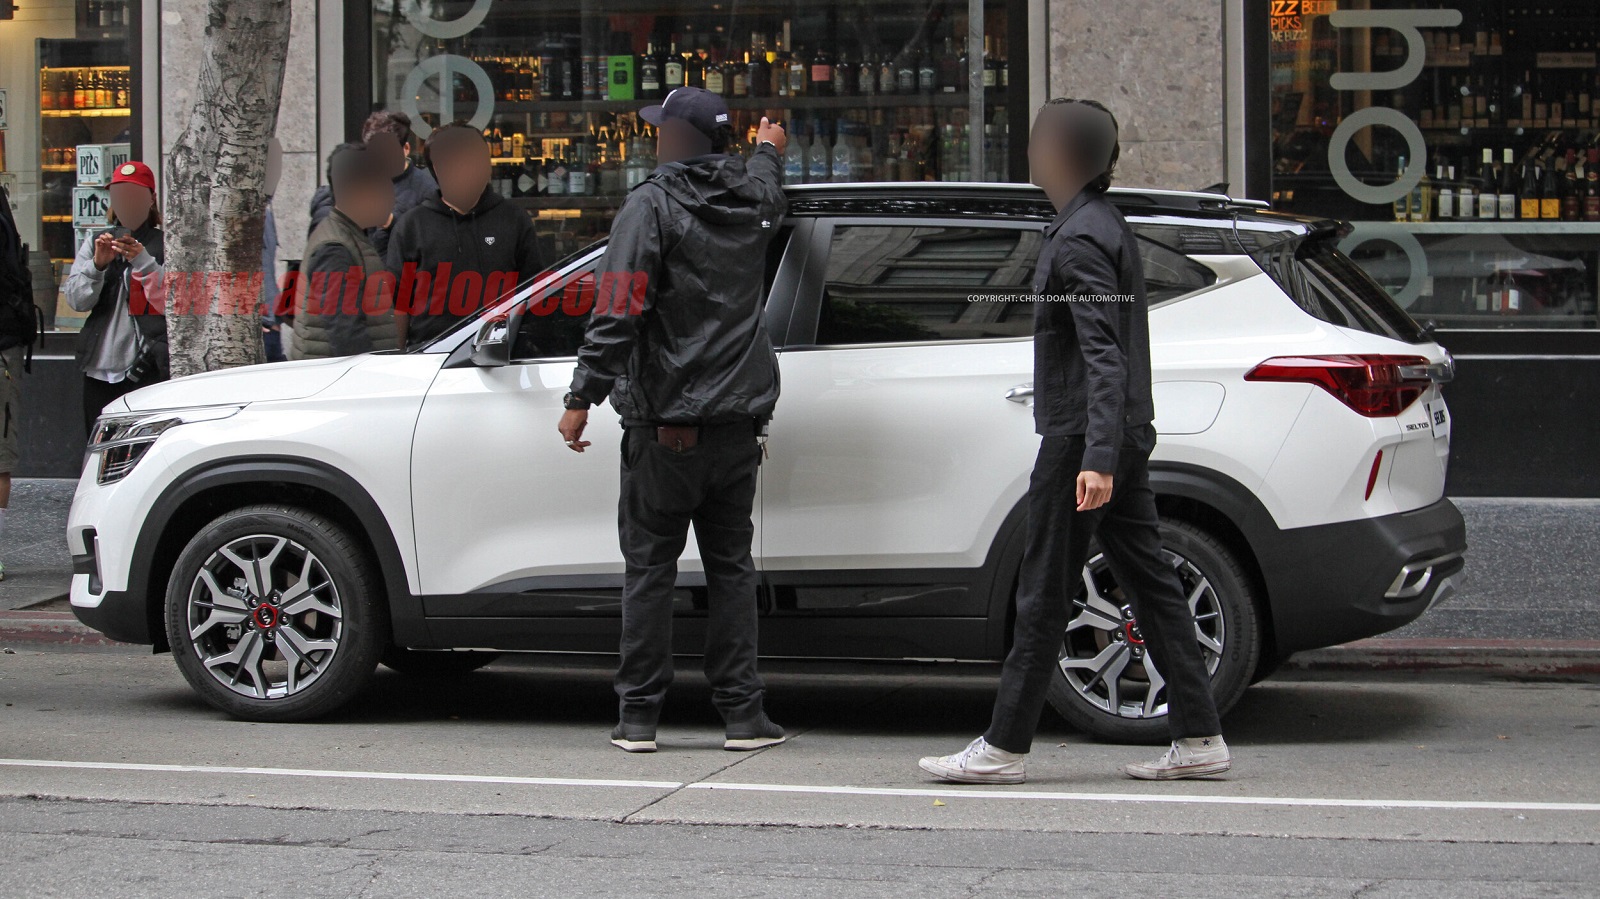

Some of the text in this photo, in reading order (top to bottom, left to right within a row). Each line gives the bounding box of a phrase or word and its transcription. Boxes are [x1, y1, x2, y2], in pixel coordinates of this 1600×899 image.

[1270, 16, 1303, 31] PICKS
[80, 154, 99, 175] PILS
[78, 197, 109, 217] PILS
[1406, 422, 1430, 431] SELTOS
[171, 601, 186, 656] KUMHO
[1231, 603, 1243, 662] KUMHO
